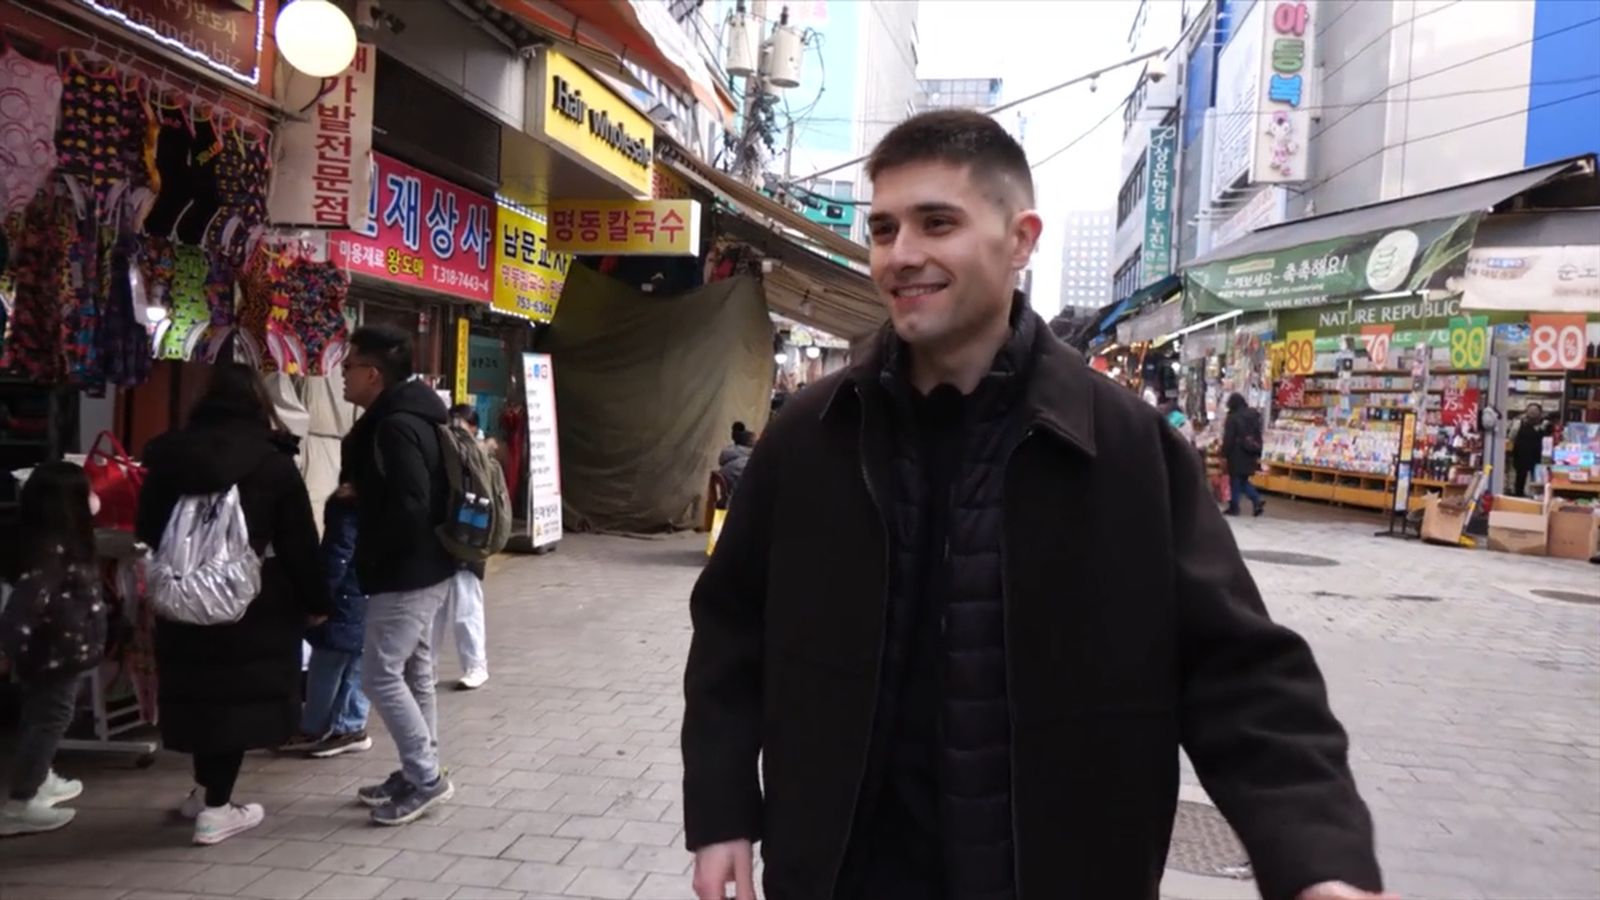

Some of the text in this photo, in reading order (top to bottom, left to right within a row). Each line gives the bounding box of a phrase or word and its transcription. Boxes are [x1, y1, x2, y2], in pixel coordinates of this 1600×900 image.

[553, 75, 586, 124] Hair
[553, 208, 685, 244] 명동칼국수
[1319, 300, 1462, 327] NATURE REPUBLIC
